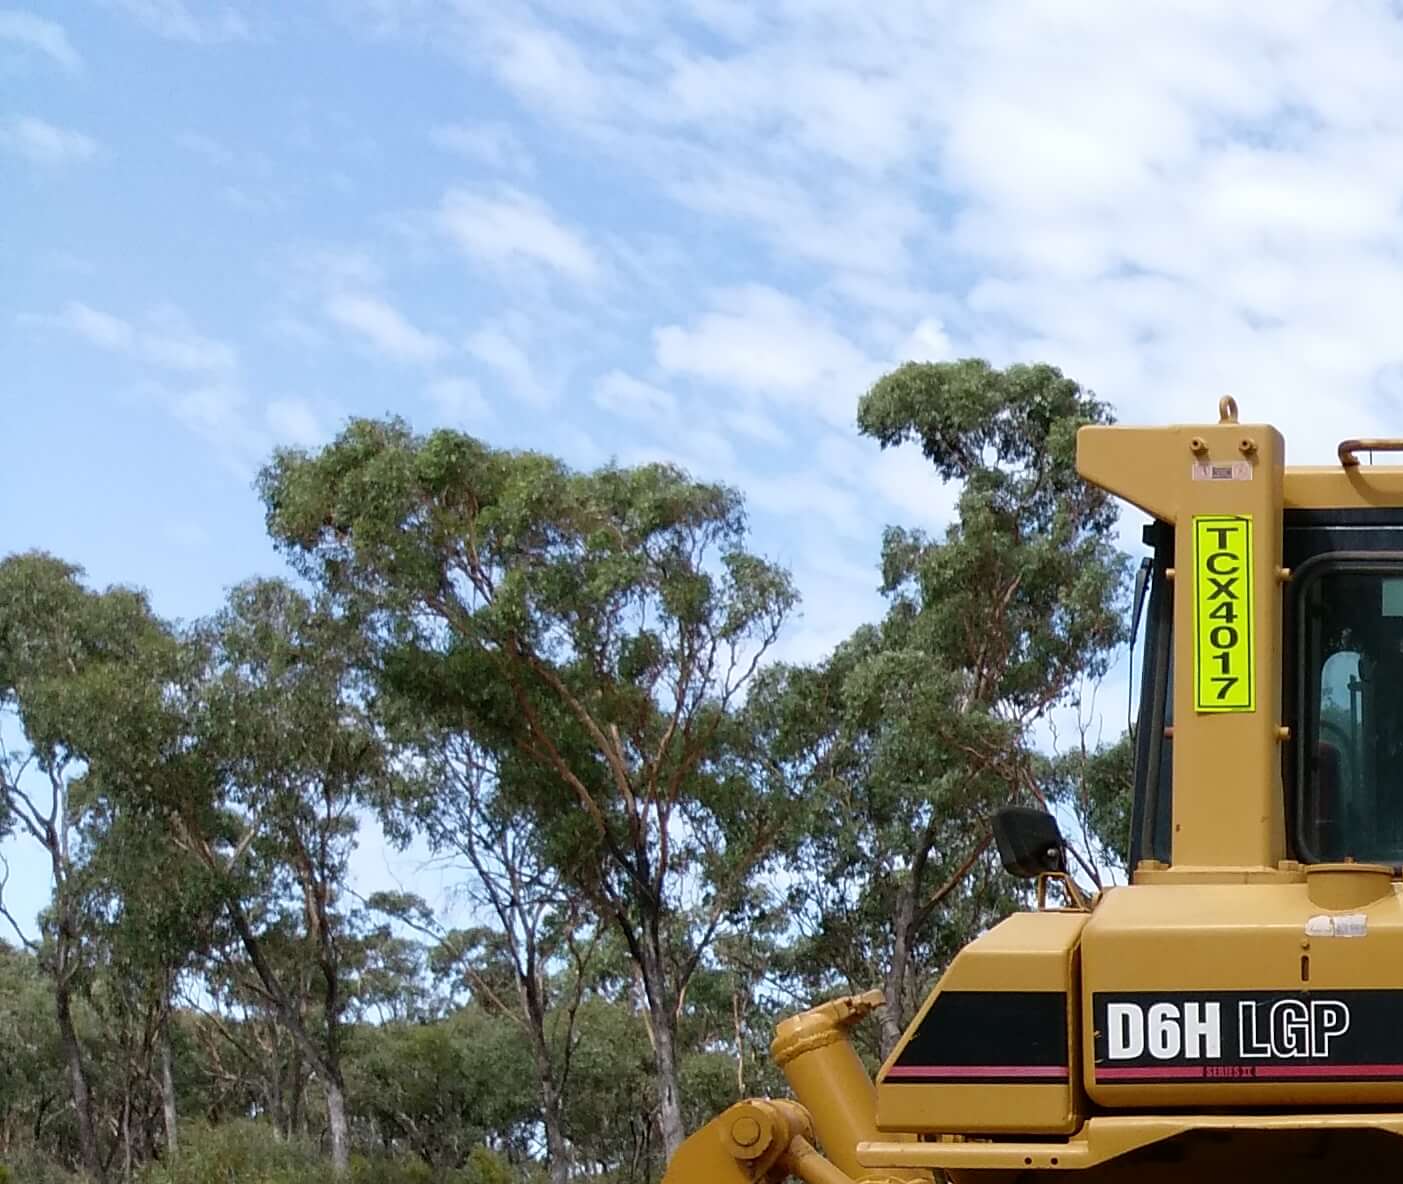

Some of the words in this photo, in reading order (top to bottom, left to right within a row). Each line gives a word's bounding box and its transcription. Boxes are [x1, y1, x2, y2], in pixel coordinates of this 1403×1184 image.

[1205, 527, 1240, 700] TCX4017
[1107, 1001, 1221, 1060] D6H
[1238, 999, 1350, 1058] LGP
